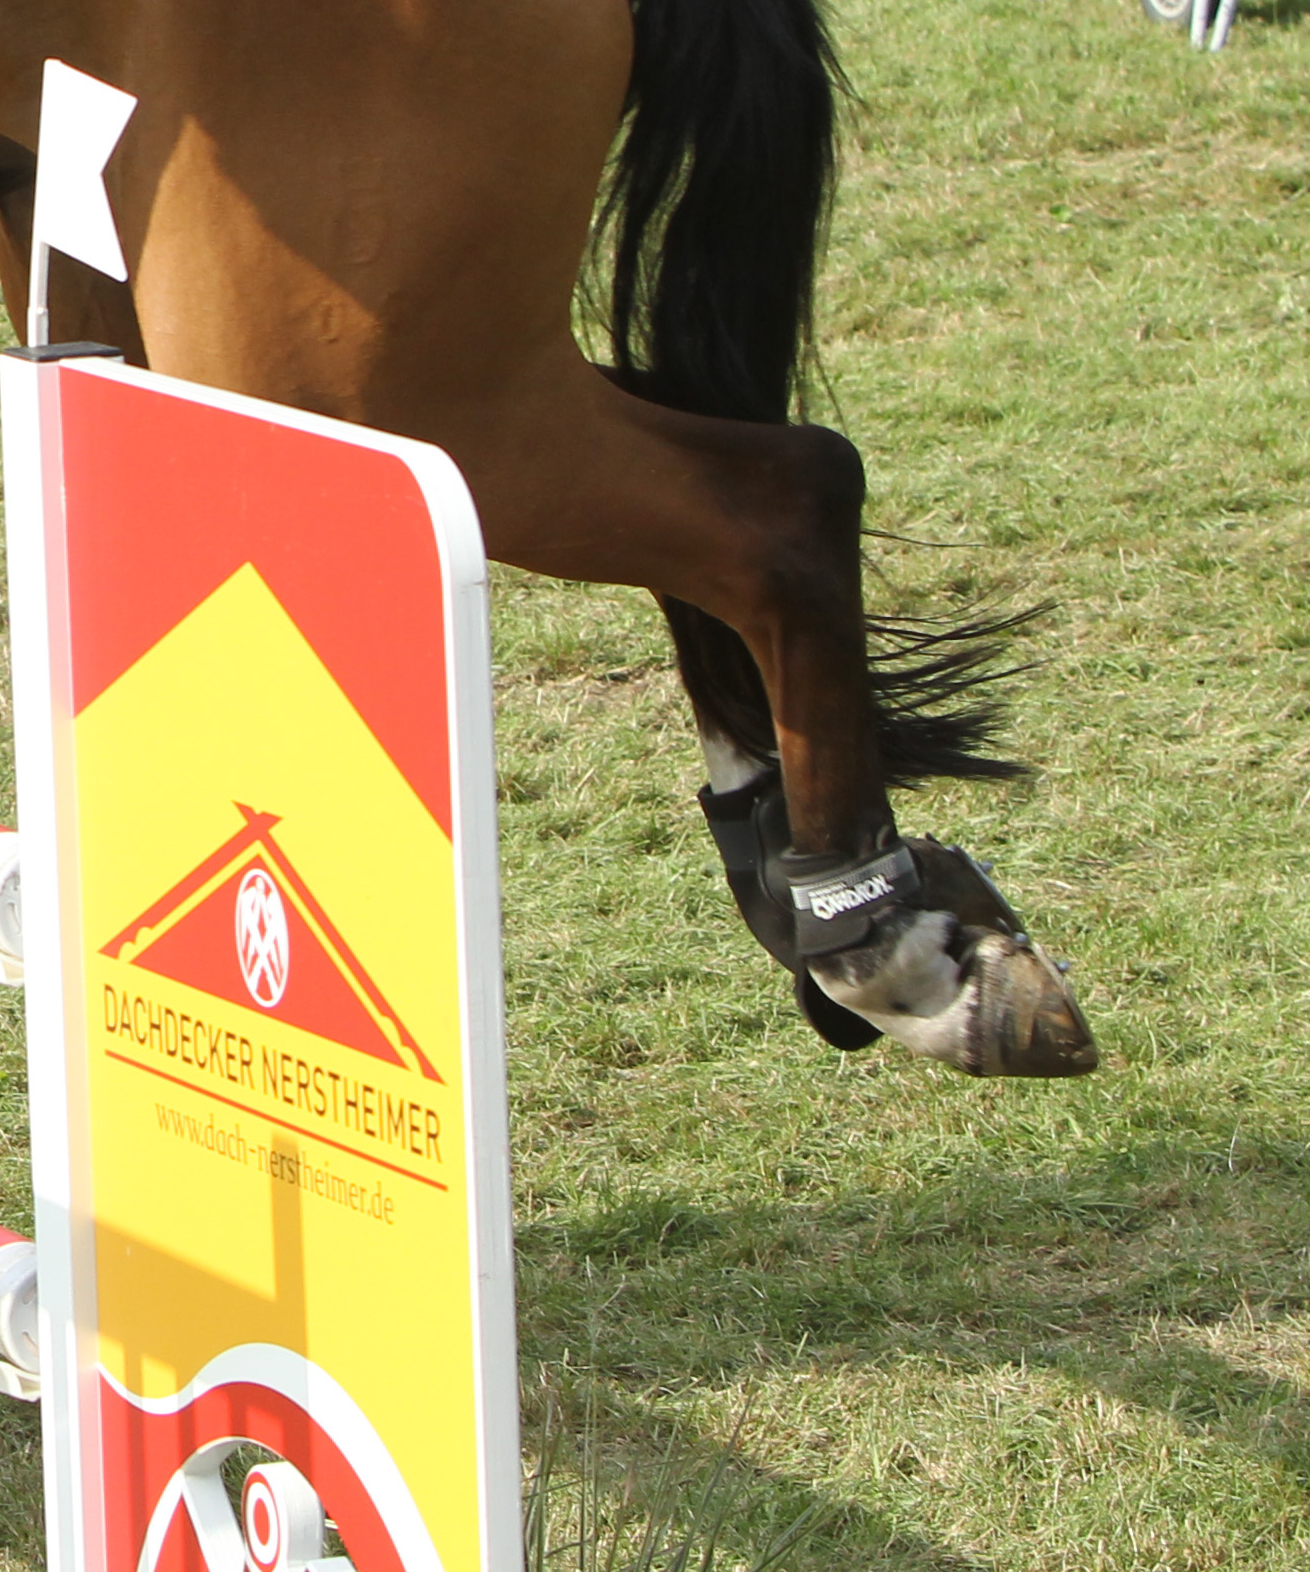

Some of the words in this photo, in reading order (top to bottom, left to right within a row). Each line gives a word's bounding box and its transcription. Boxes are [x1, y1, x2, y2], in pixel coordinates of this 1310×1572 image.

[104, 984, 255, 1089] DACHDECKER
[262, 1044, 443, 1164] NERSTHEIMER
[155, 1102, 395, 1225] www.dach-nerstheimer.de
